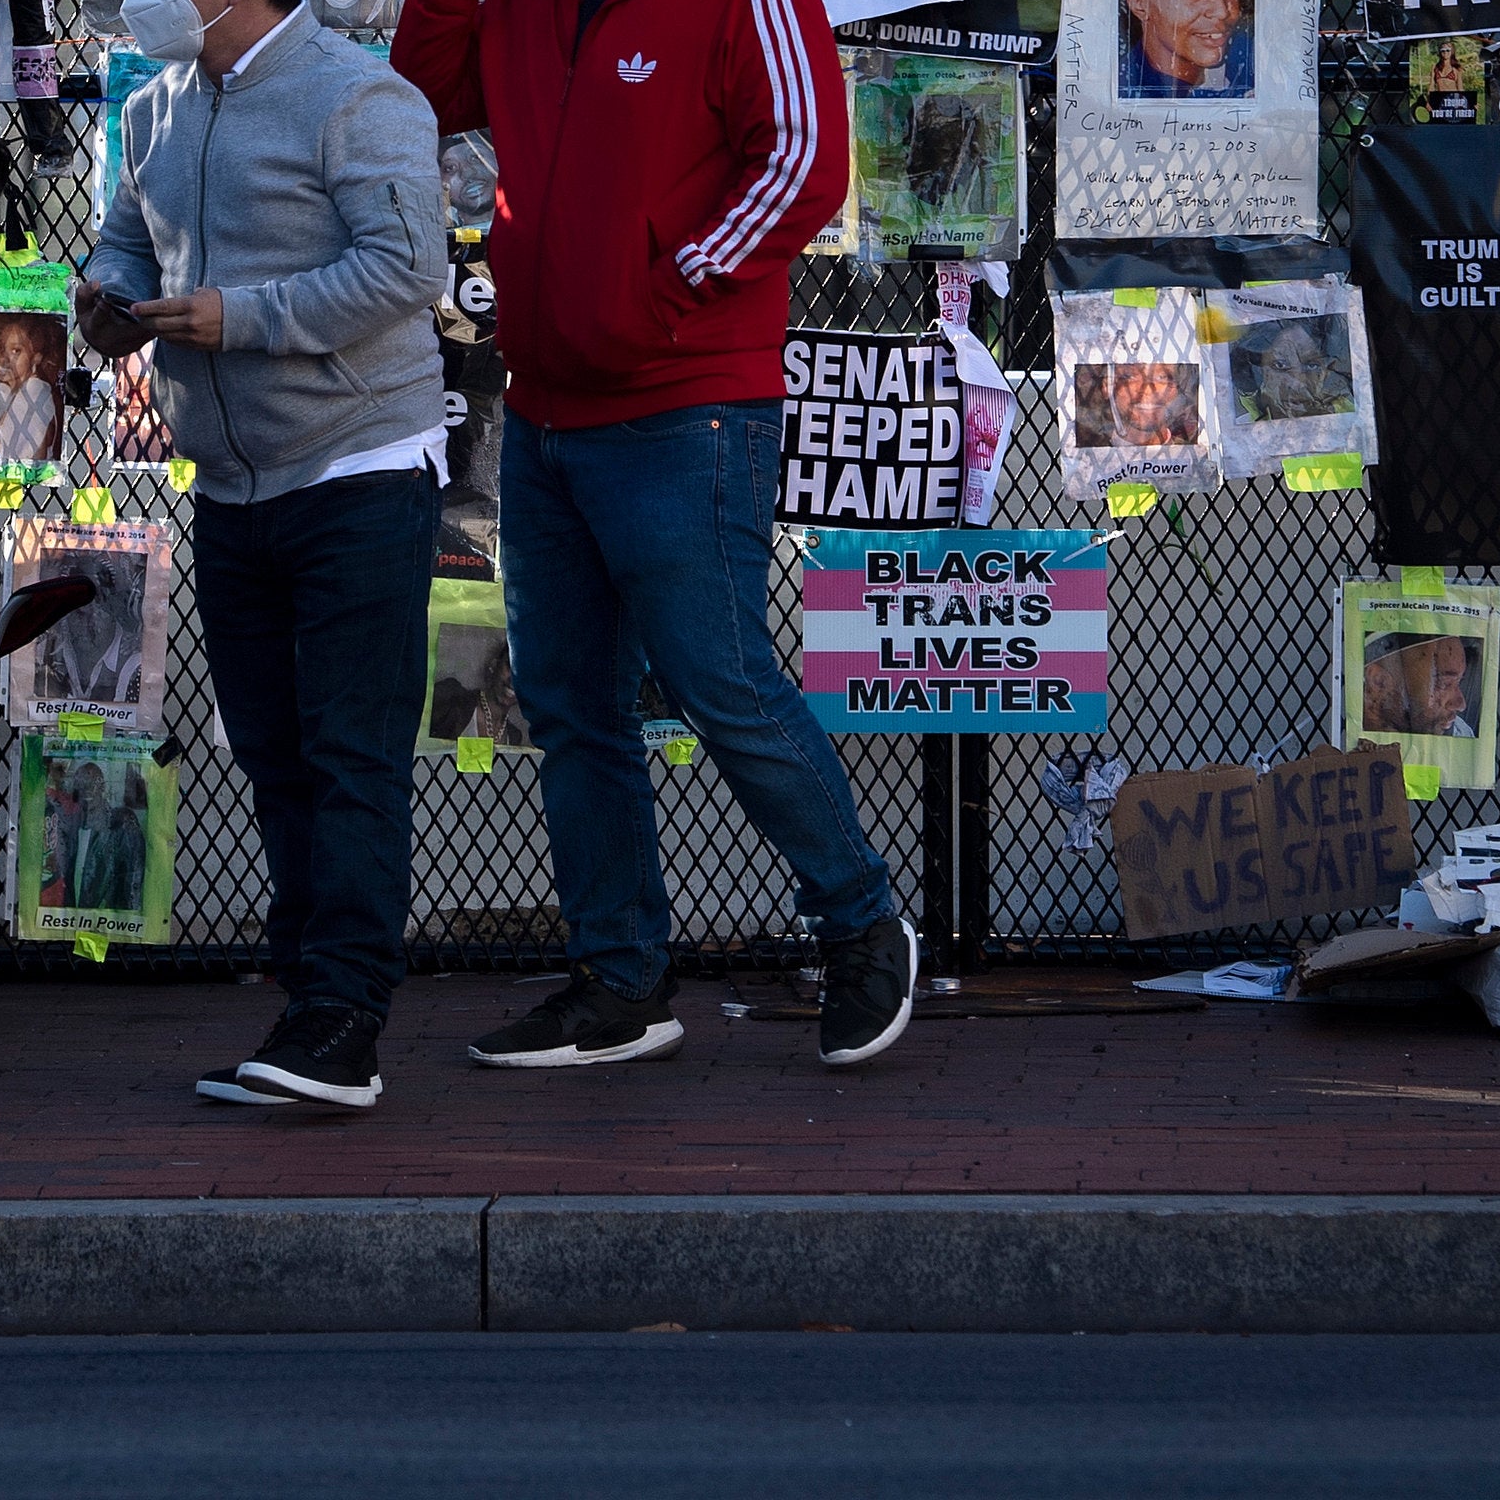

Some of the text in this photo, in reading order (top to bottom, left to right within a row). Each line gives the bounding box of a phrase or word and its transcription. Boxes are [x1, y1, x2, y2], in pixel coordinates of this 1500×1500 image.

[1370, 602, 1400, 610] Spencer
[1402, 602, 1429, 610] McCain
[1432, 603, 1450, 611] June
[1138, 760, 1399, 845] WE KEEP
[1184, 824, 1402, 915] US SAFE
